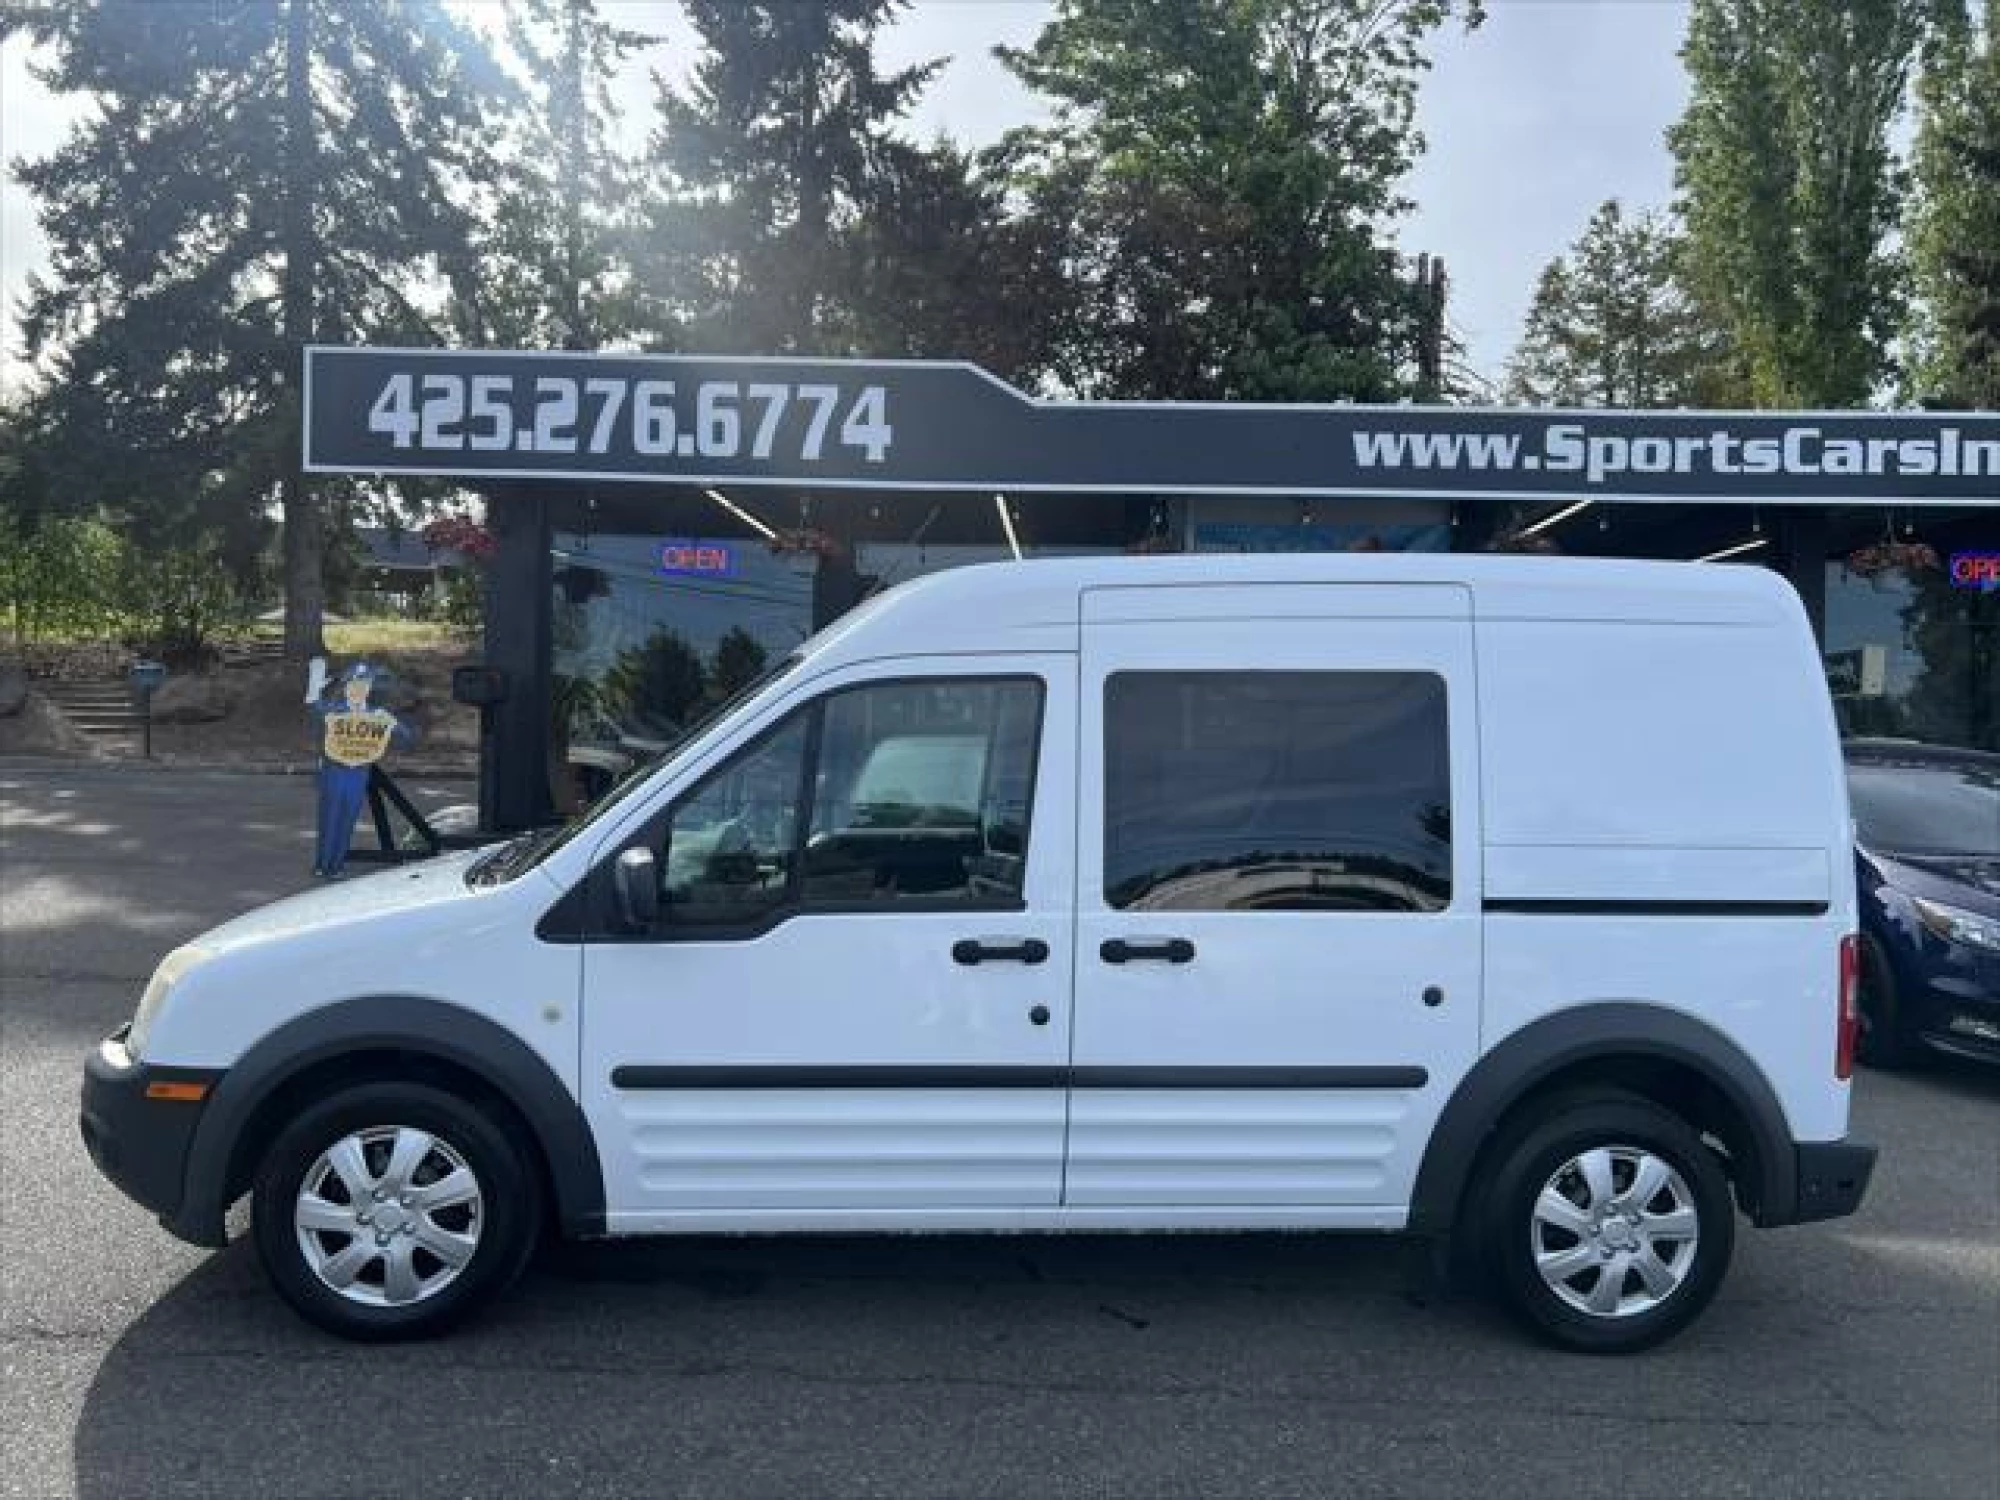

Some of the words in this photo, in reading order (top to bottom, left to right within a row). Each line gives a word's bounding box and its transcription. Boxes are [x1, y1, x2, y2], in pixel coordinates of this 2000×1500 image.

[367, 373, 893, 462] 425.276.6774
[1352, 423, 2000, 482] www.SportsCarsIn
[661, 546, 729, 570] OPEN
[332, 718, 389, 738] SLOW
